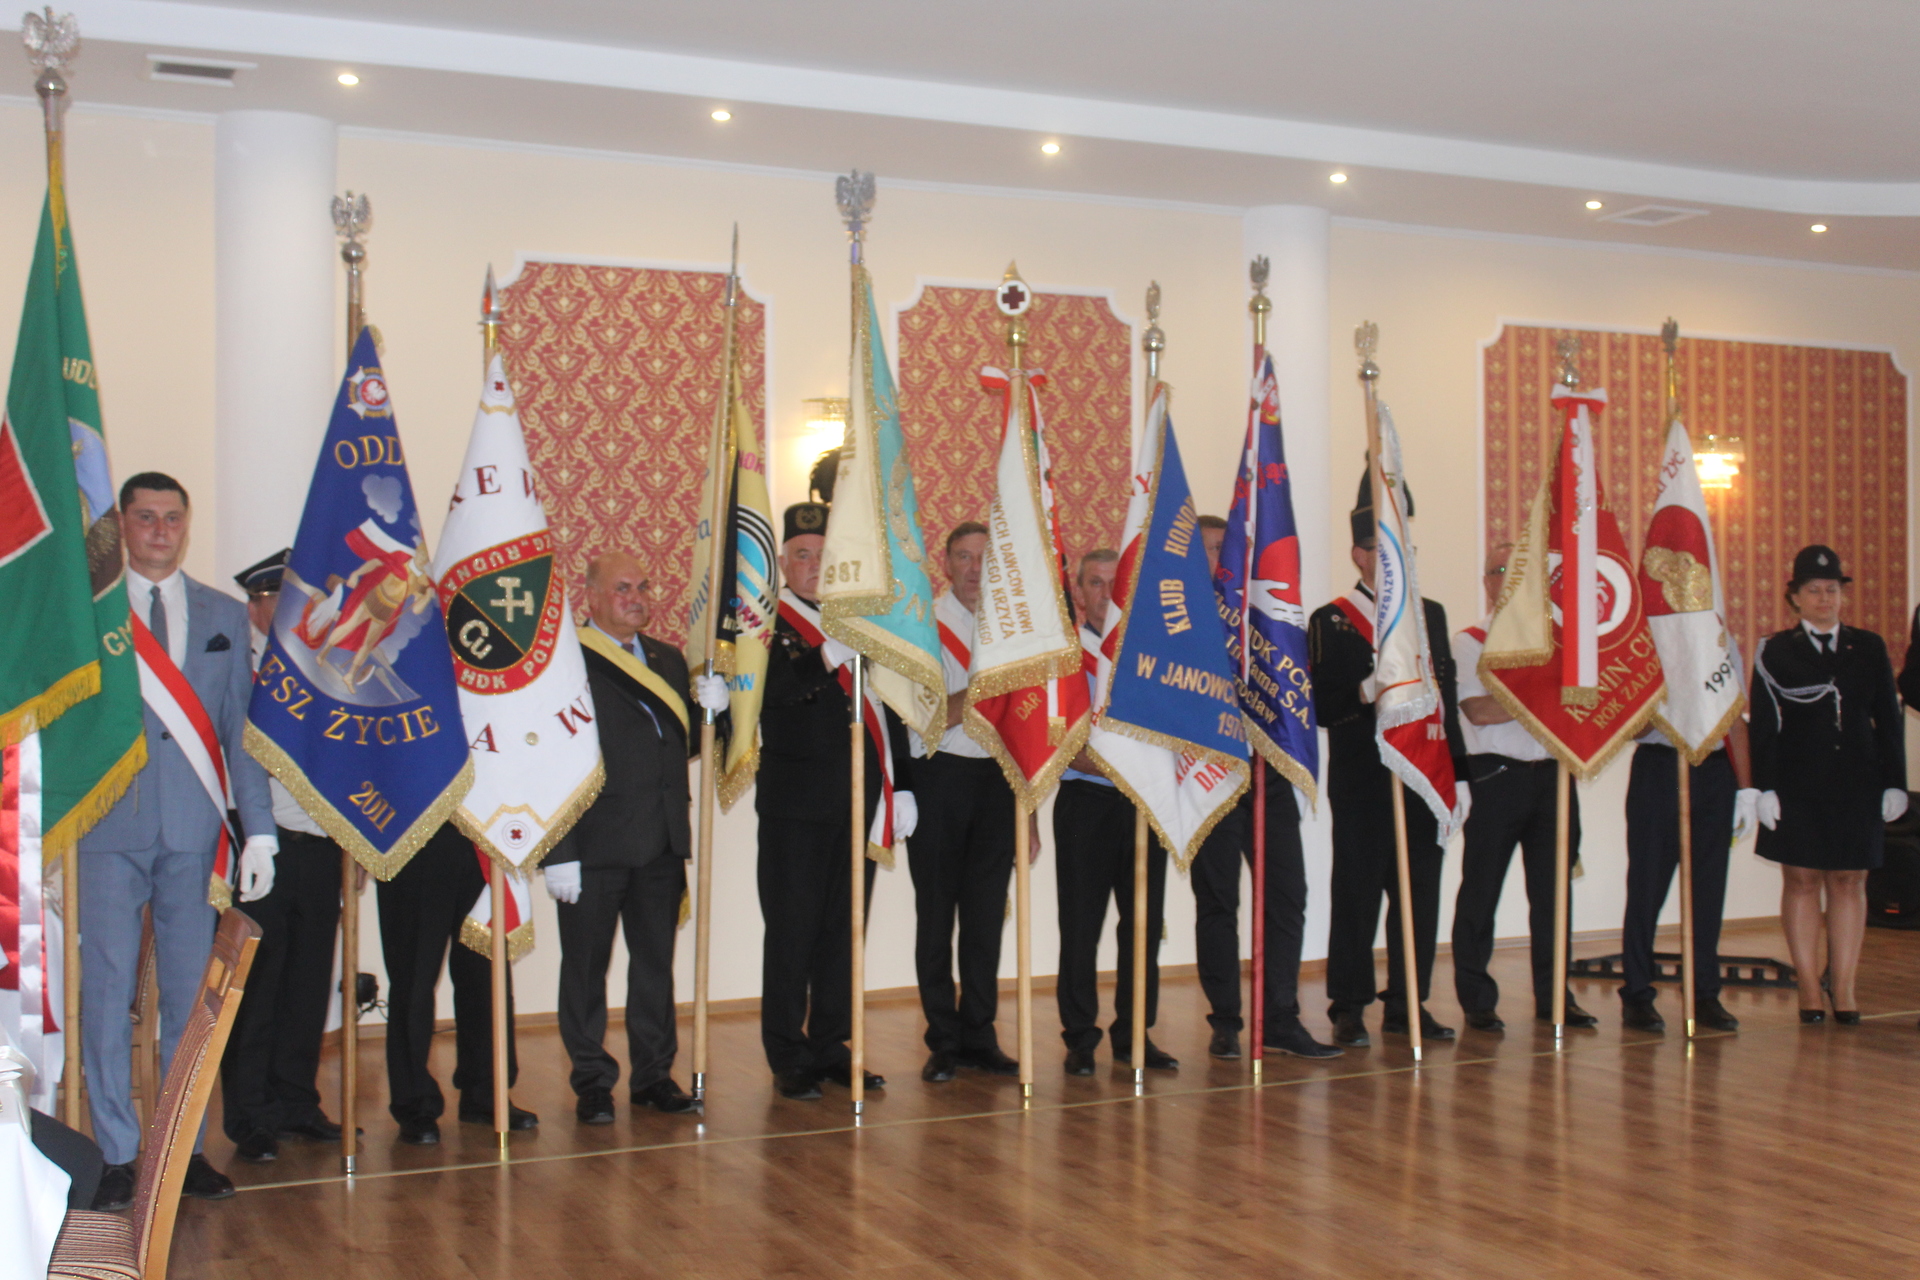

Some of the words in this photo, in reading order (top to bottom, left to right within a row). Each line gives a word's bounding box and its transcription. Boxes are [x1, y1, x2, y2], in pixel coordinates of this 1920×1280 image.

[1013, 601, 1035, 635] KRWI
[1159, 579, 1193, 636] KLUB
[459, 619, 493, 660] Cu
[460, 668, 507, 689] HDK
[1137, 653, 1157, 679] W
[1276, 654, 1313, 702] PCK
[323, 706, 441, 747] ŻYCIE
[1015, 691, 1043, 721] DAR
[1280, 689, 1310, 730] S.A.
[1592, 697, 1626, 730] ROK
[348, 780, 397, 834] 2011
